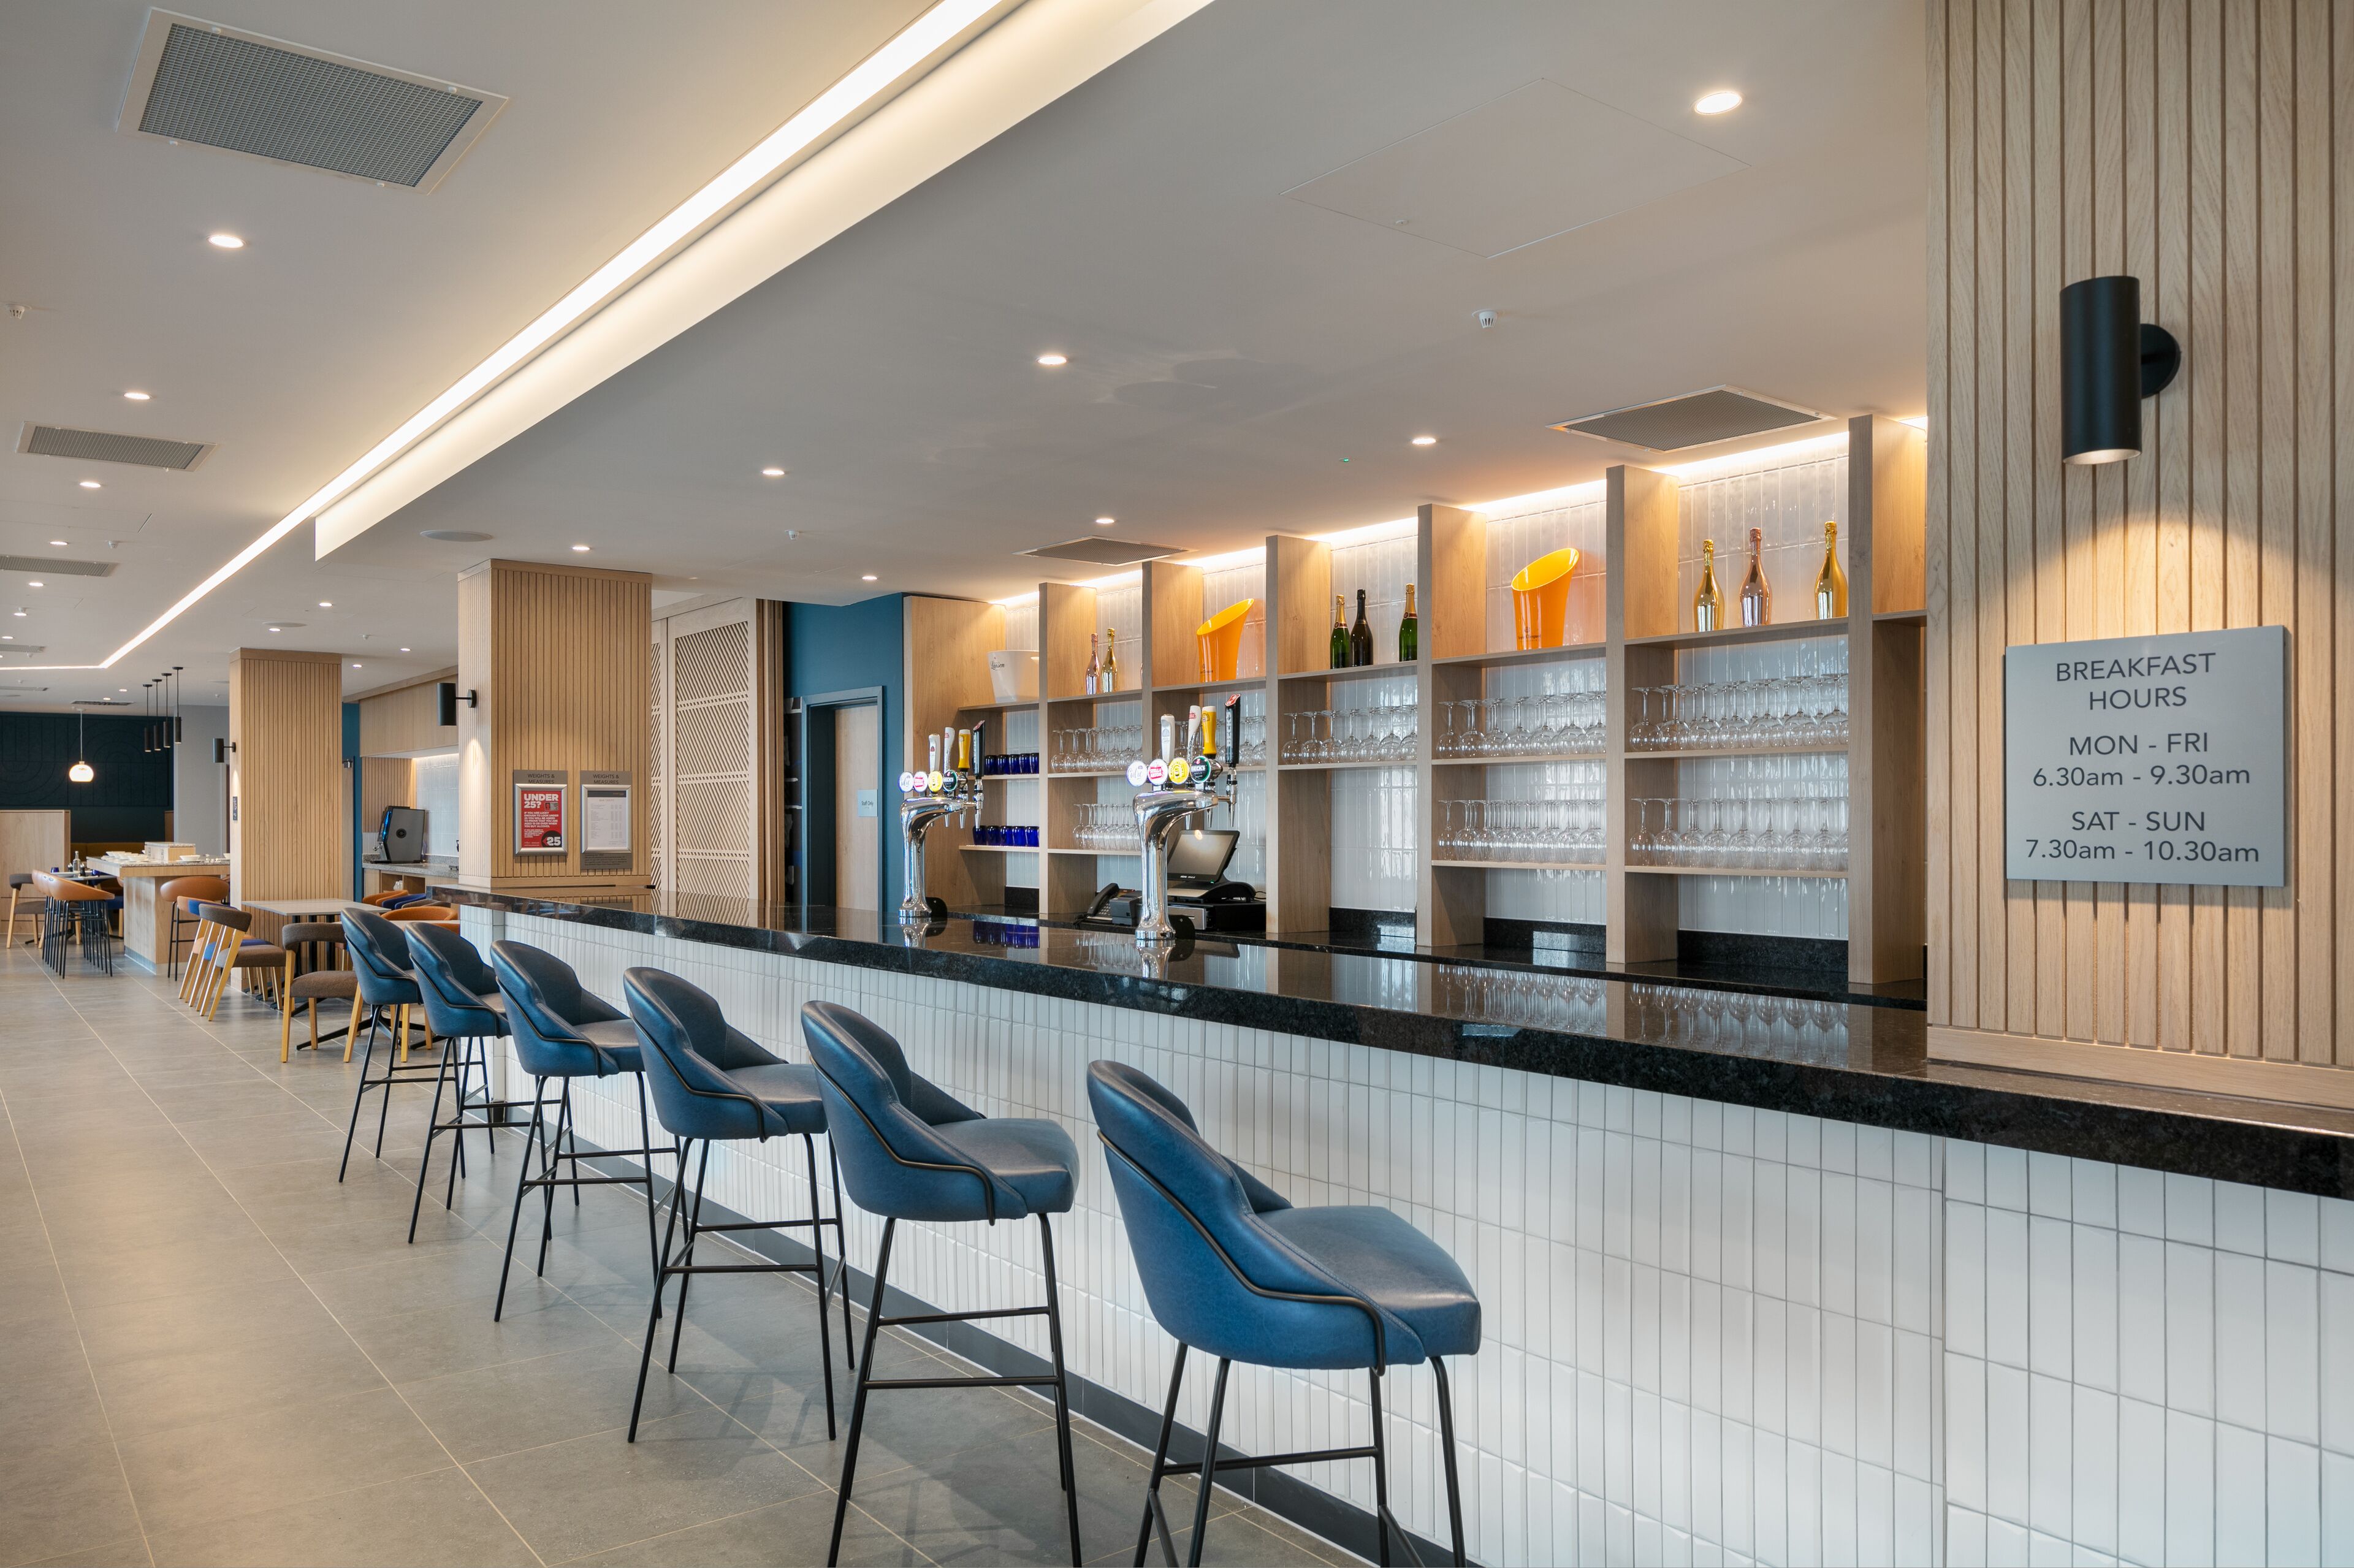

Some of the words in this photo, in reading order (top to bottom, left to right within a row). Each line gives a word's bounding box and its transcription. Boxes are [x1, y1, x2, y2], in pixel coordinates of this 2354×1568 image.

[2056, 652, 2217, 682] BREAKFAST
[2089, 686, 2187, 710] HOURS
[2070, 735, 2138, 756] MON
[2167, 732, 2208, 753] FRI
[2033, 767, 2124, 787] 6.30am
[2150, 764, 2250, 785] 9.30am
[2071, 811, 2120, 831] SAT
[2146, 811, 2205, 832] SUN
[2025, 839, 2116, 860] 7.30am
[2144, 840, 2260, 863] 10.30am
